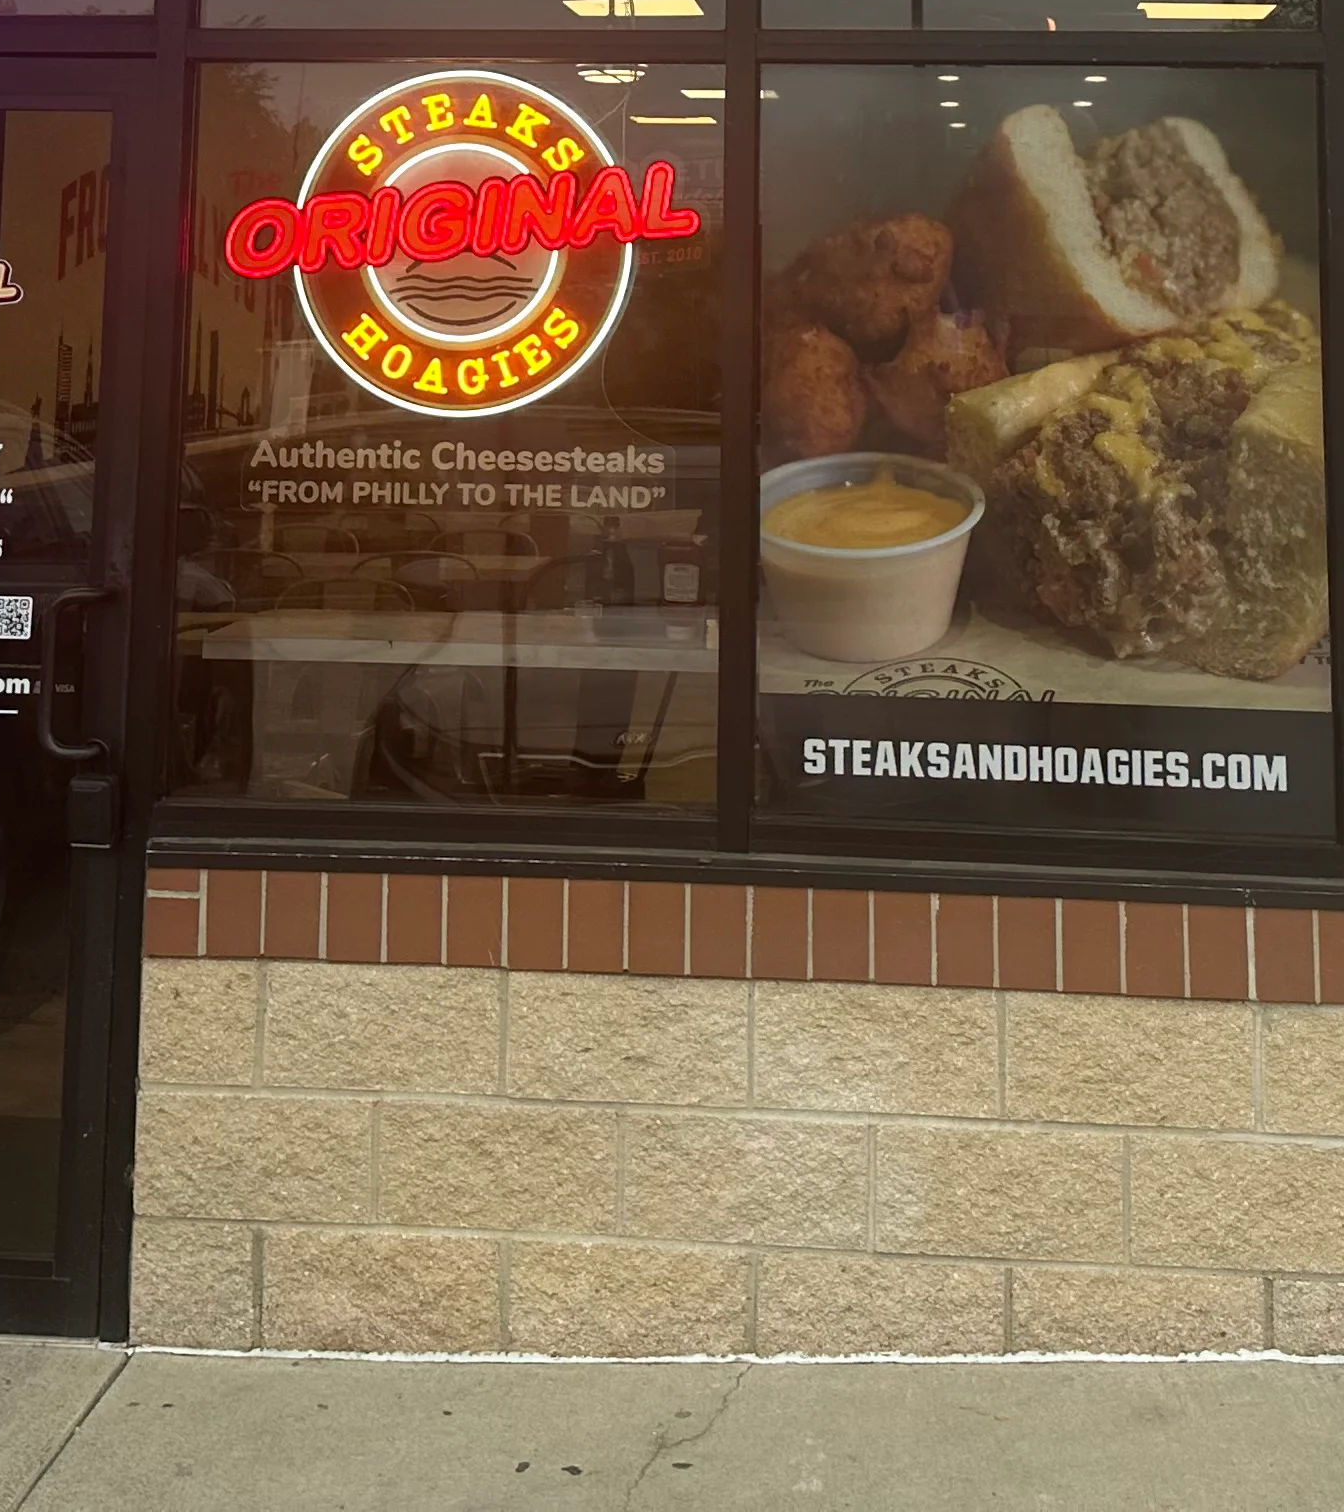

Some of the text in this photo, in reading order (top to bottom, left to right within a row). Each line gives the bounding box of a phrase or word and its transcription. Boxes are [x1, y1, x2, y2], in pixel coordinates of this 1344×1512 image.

[348, 93, 585, 176] STEAKS
[225, 161, 701, 278] ORIGINAL
[341, 308, 579, 395] HOAGIES
[250, 440, 665, 474] Authentic Cheesesteaks
[248, 480, 666, 508] “FROM PHILLY TO THE LAND”
[54, 683, 76, 694] VISA
[803, 678, 835, 689] The
[873, 662, 1006, 689] STEAKS
[802, 737, 1288, 792] STEAKSANDHOAGIES.COM
